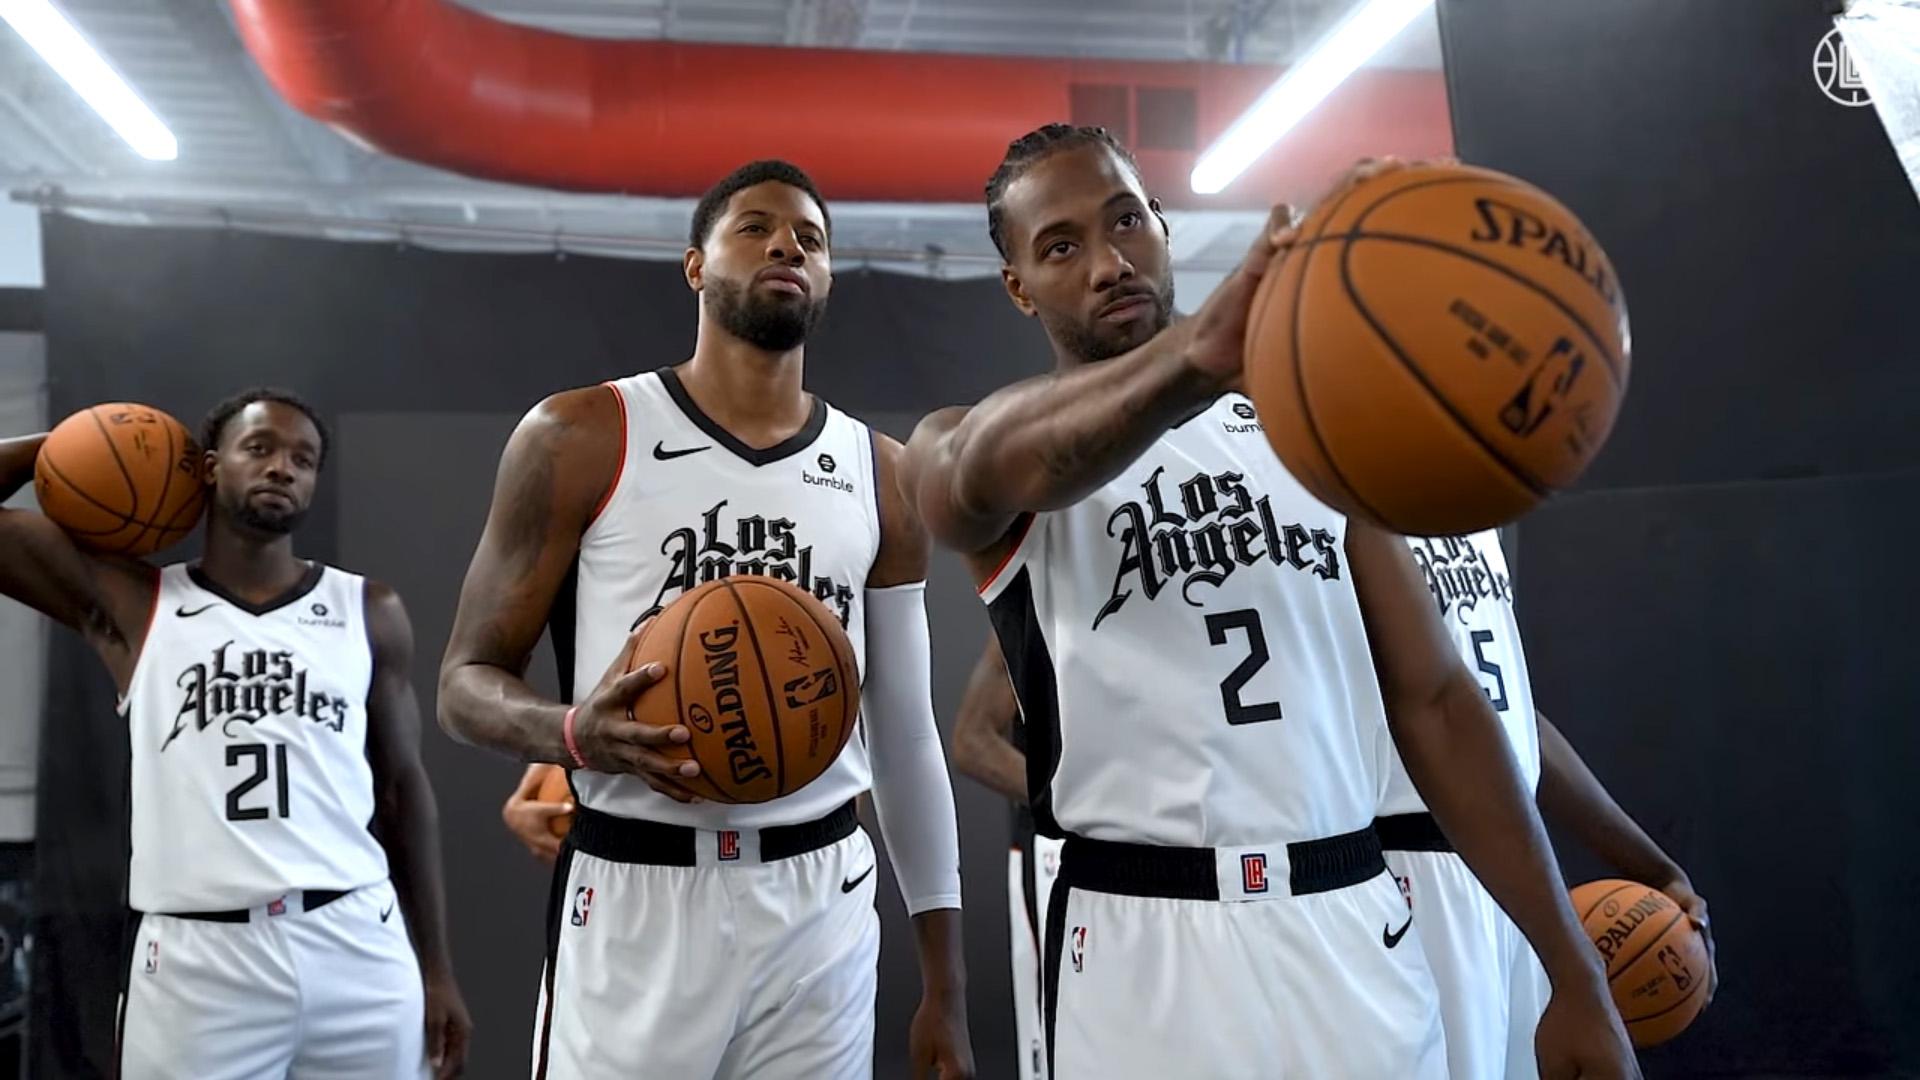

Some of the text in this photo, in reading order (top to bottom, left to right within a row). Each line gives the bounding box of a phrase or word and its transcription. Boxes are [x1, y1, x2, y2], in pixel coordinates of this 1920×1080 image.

[802, 469, 854, 493] bumble
[1141, 466, 1255, 528] Los
[698, 499, 796, 560] Los
[1092, 494, 1340, 631] Angeles
[210, 640, 294, 683] Los
[1204, 608, 1282, 725] 2
[160, 663, 350, 753] Angeles
[225, 743, 291, 821] 21
